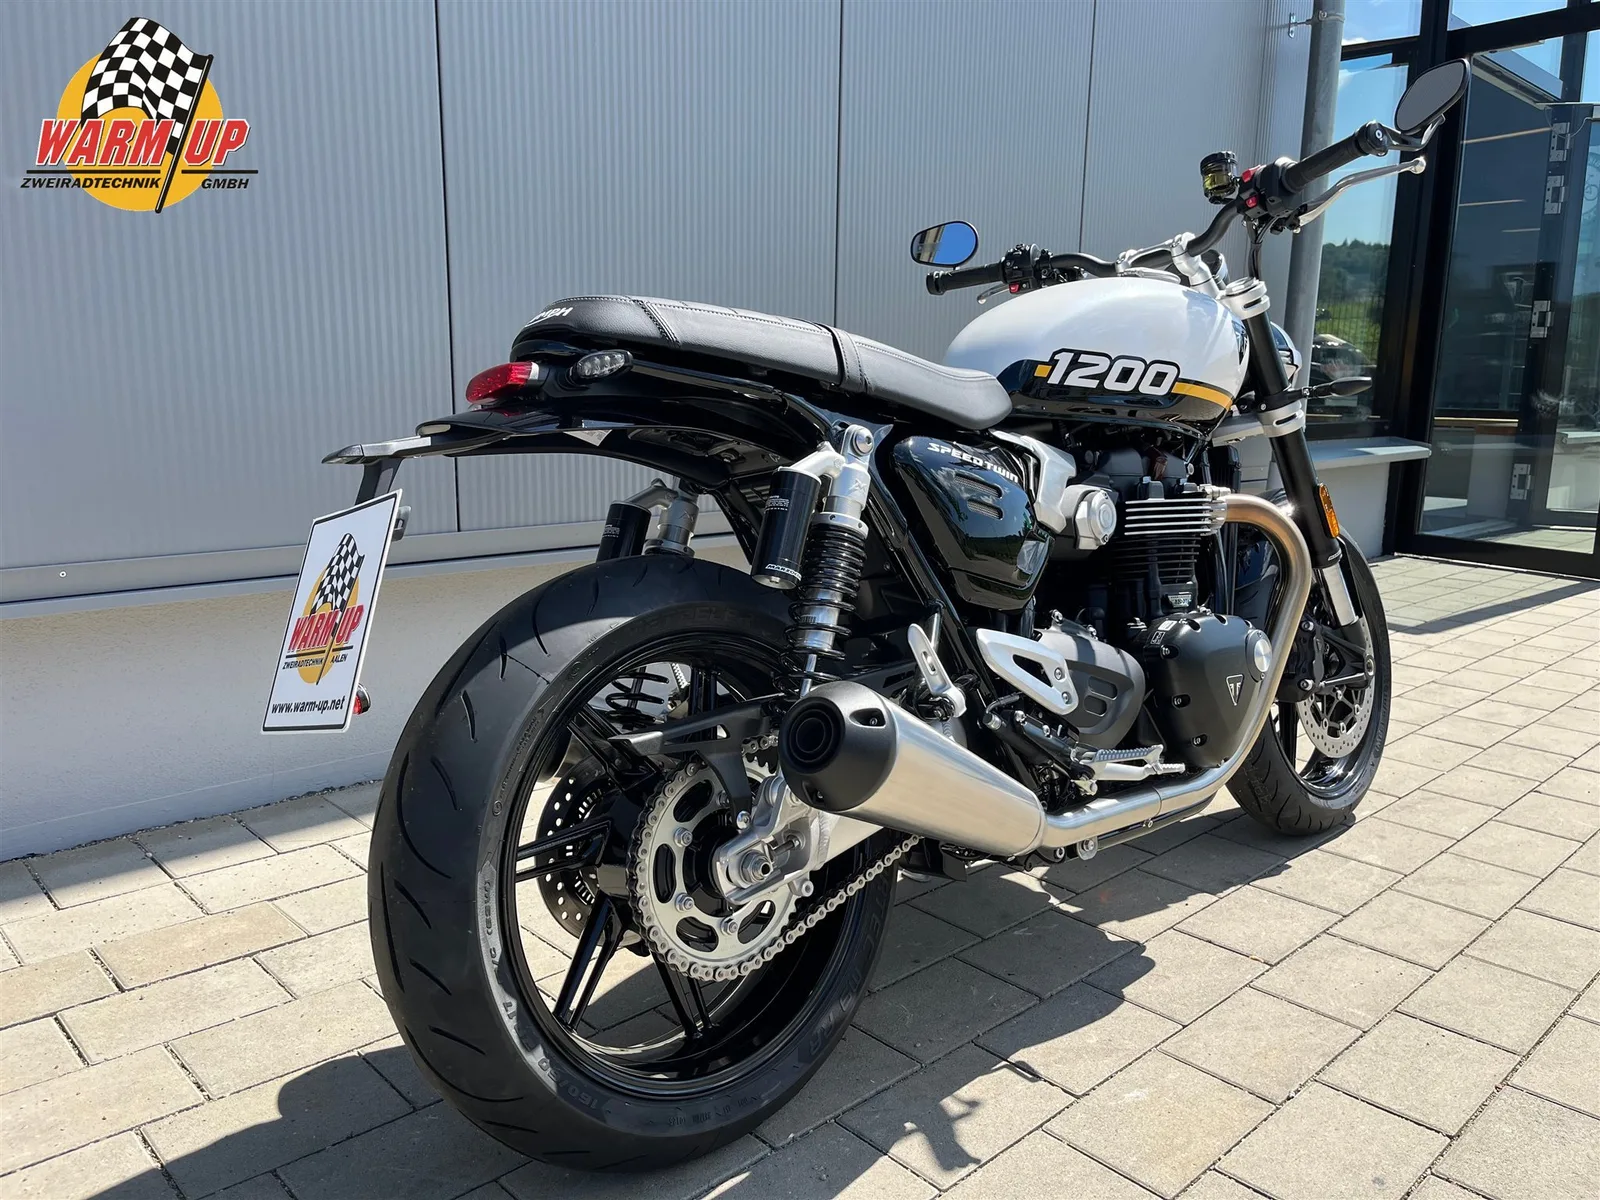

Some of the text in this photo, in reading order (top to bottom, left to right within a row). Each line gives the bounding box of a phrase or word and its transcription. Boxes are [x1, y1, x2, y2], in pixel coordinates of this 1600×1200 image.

[1047, 352, 1178, 396] 1200
[927, 442, 1018, 483] SPEED TWIN
[288, 604, 365, 652] WARM UP
[283, 654, 347, 670] ZWEIRADTECHNIK AALEN
[271, 696, 346, 714] www.warm-up.net
